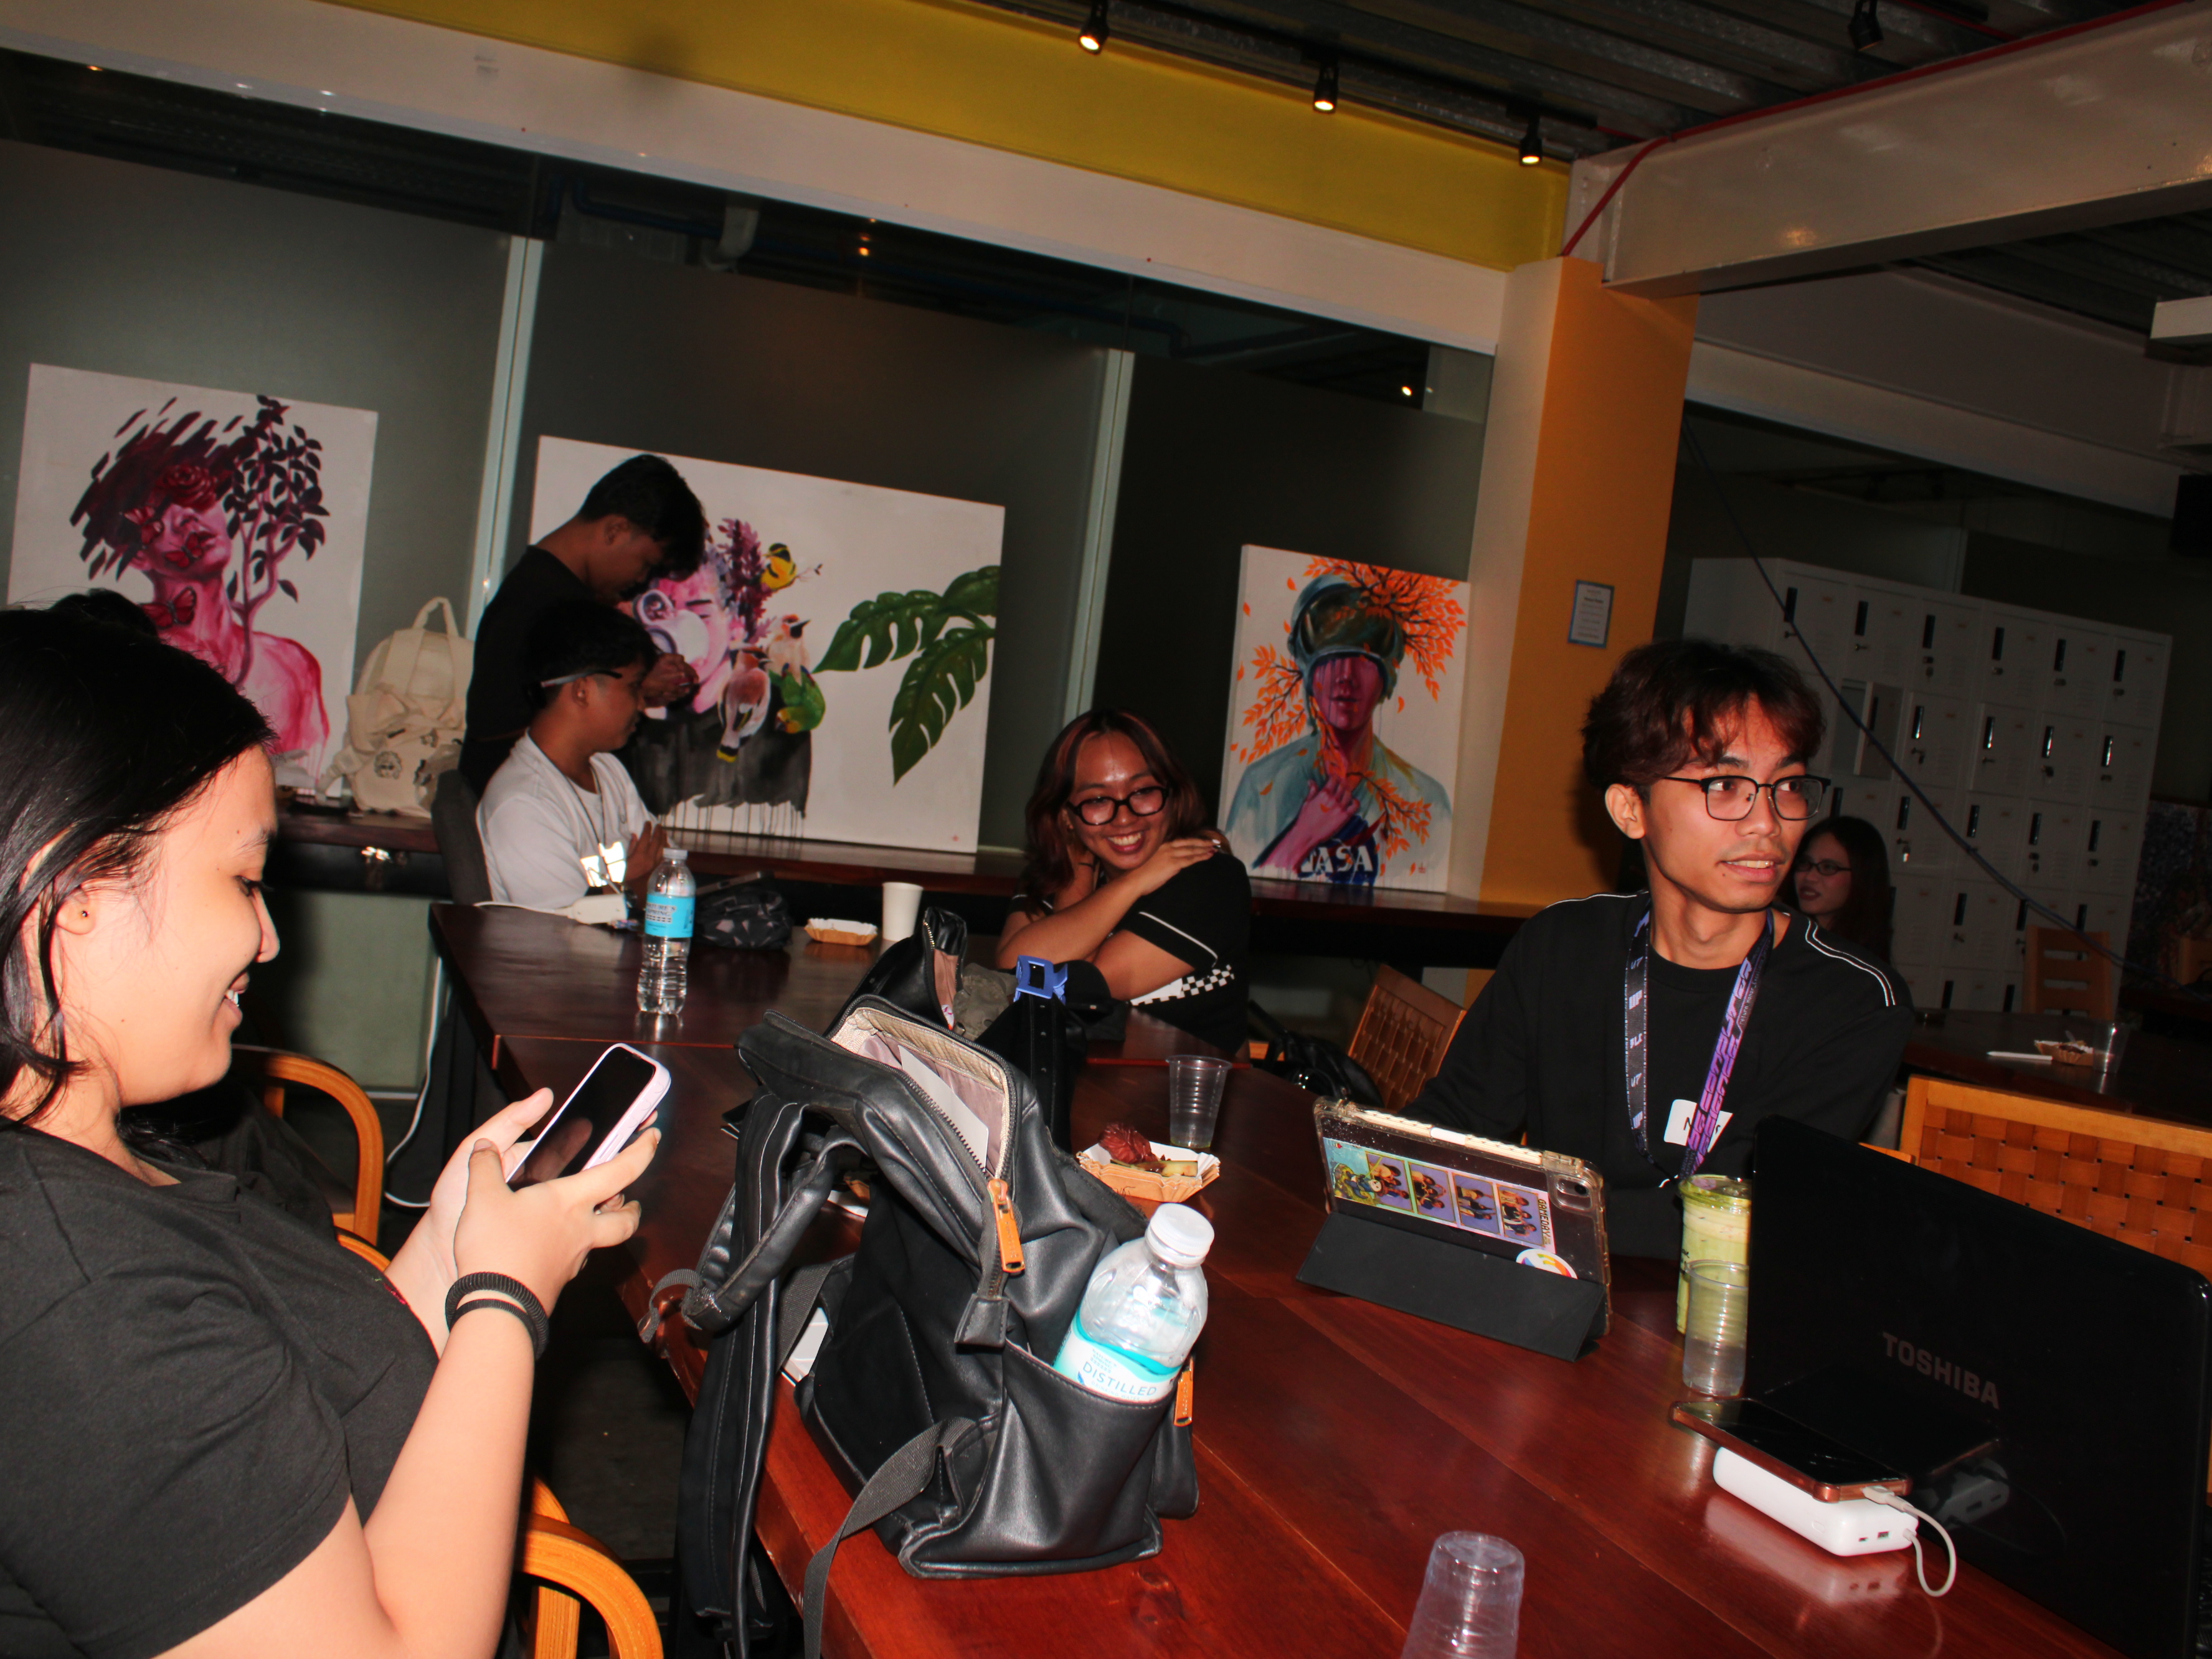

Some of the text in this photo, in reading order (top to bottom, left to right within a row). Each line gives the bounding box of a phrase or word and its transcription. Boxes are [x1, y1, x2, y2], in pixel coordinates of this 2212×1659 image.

[1538, 1198, 1551, 1237] GAMEDAY
[1083, 1361, 1157, 1396] DISTILLED
[1883, 1331, 2000, 1410] TOSHIBA
